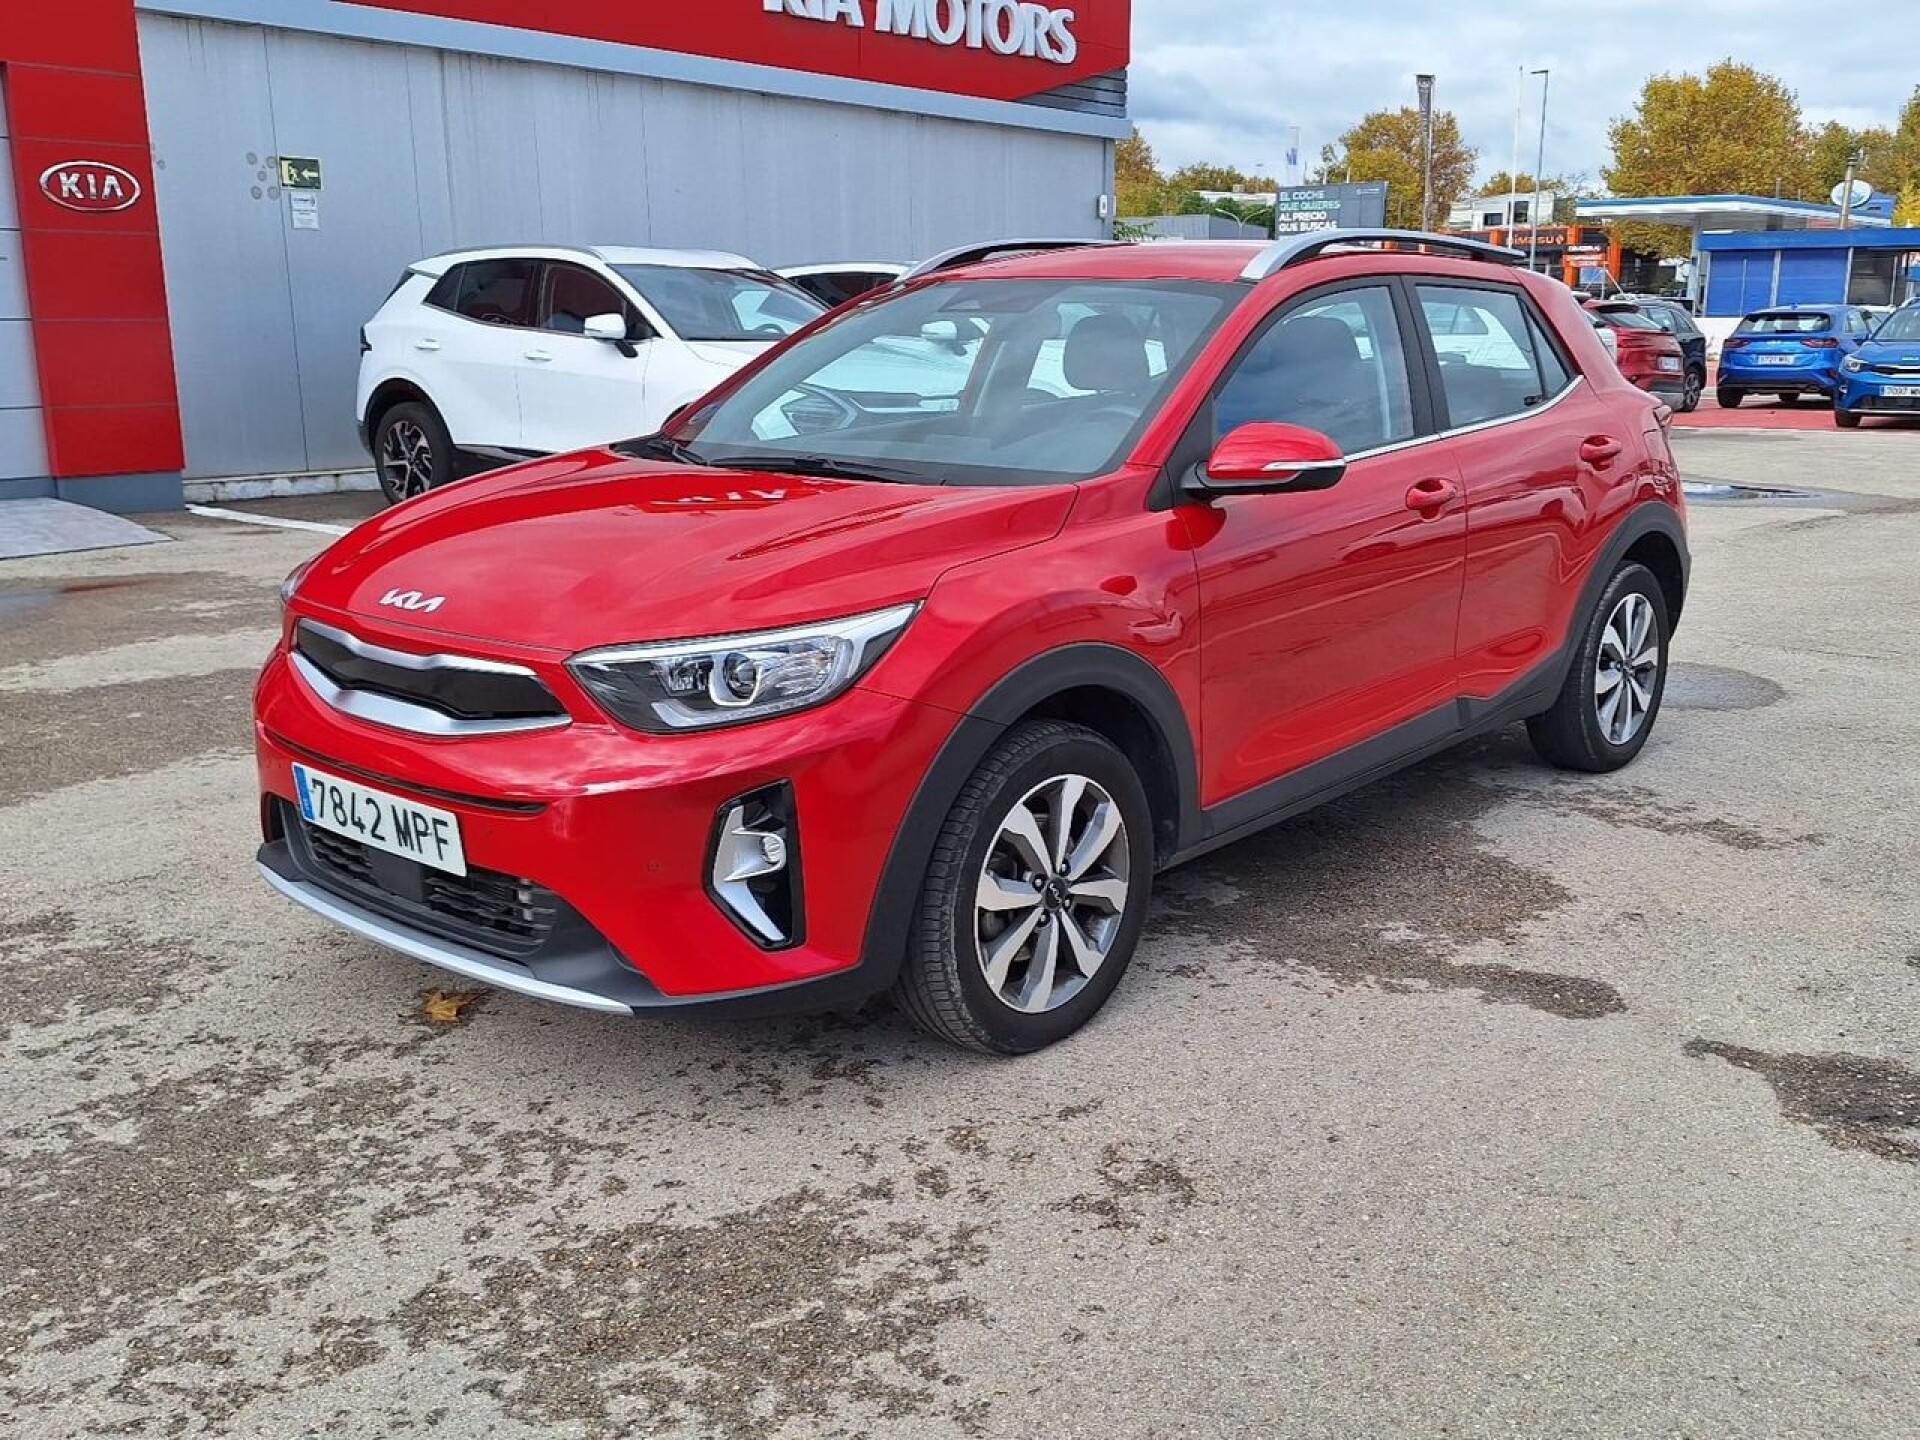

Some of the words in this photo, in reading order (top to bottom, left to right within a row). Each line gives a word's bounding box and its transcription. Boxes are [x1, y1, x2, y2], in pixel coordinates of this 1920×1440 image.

[875, 0, 1077, 64] MOTORS
[58, 171, 124, 200] KIA
[1293, 190, 1326, 201] COCHE
[1279, 201, 1300, 211] QUE
[1279, 212, 1292, 222] AL
[1292, 210, 1327, 221] PRECIO
[1279, 222, 1299, 232] QUE
[1300, 220, 1338, 232] BUSCAS
[311, 777, 387, 843] 7842
[390, 803, 449, 862] MPF
